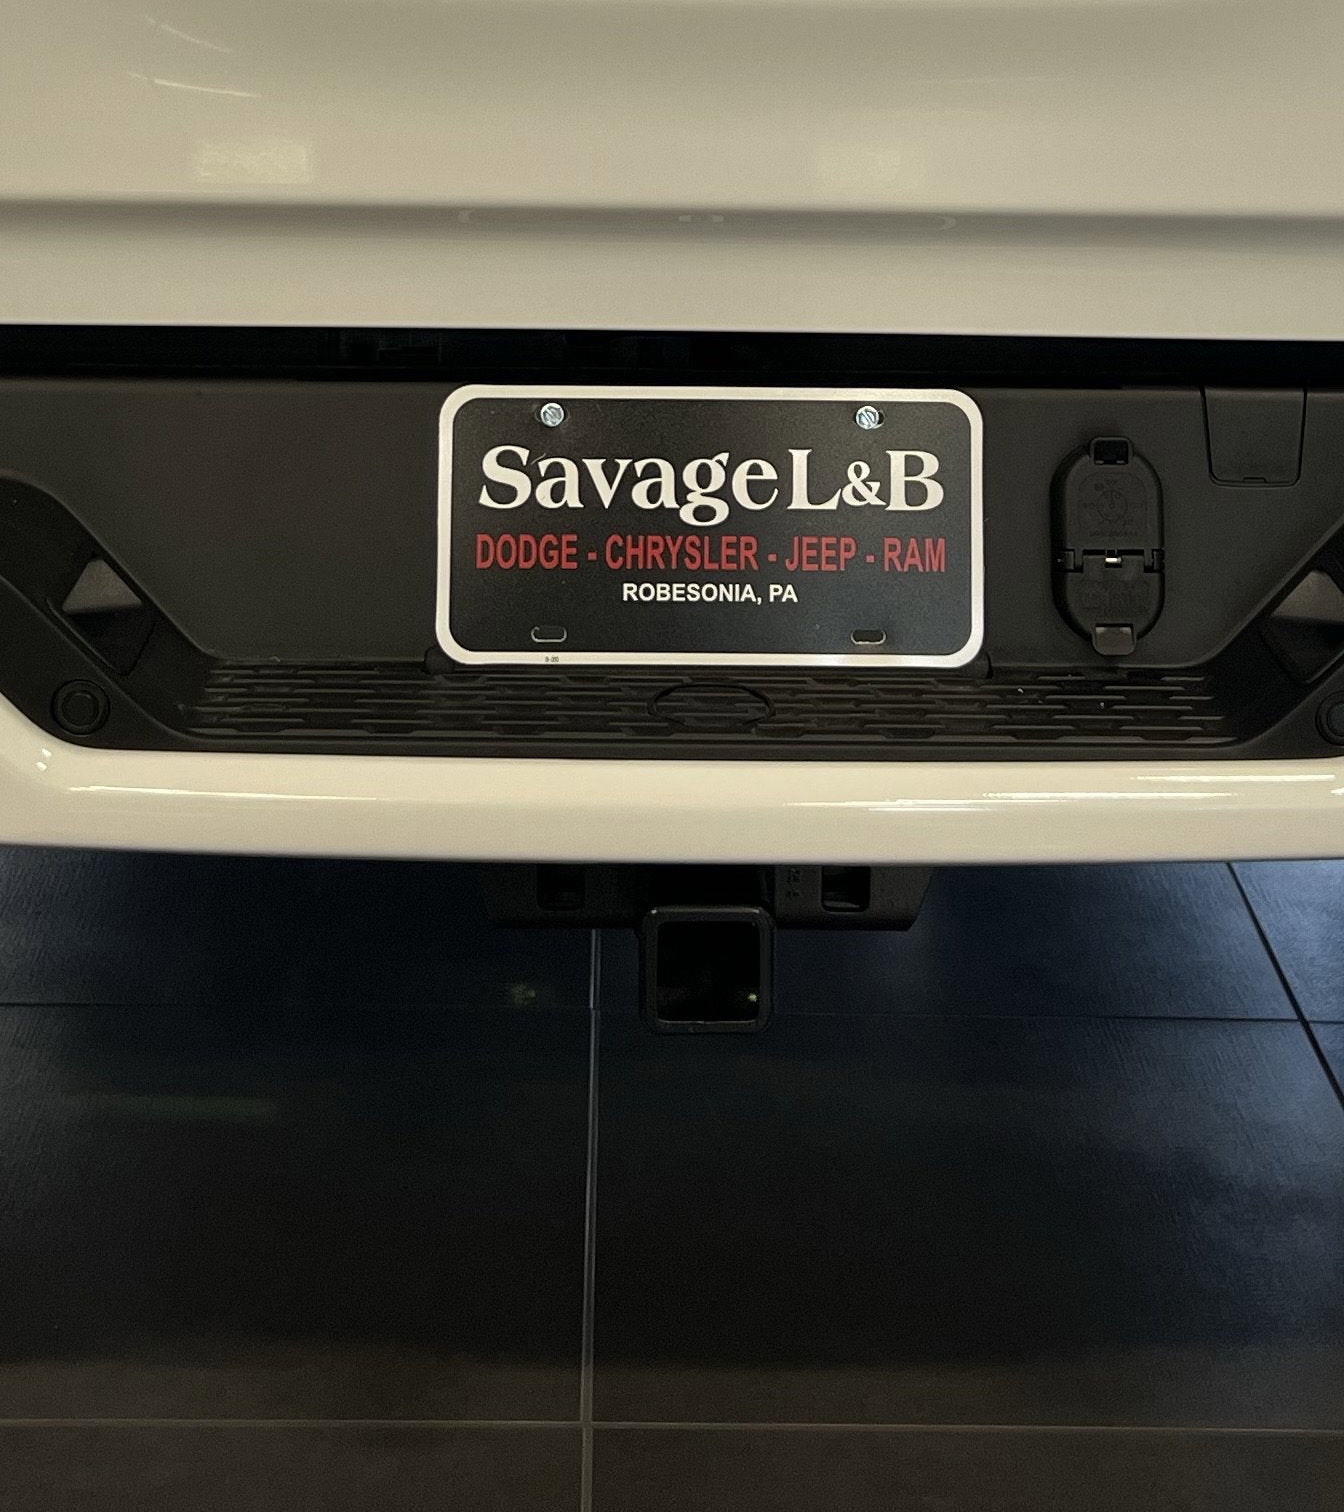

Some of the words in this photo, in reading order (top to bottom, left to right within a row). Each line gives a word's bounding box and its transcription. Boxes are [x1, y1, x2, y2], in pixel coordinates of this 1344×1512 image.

[478, 444, 779, 527] Savage
[787, 448, 945, 511] L&B
[474, 532, 579, 571] DODGE
[604, 534, 759, 572] CHRYSLER
[784, 536, 857, 573] JEEP
[883, 537, 946, 574] RAM
[622, 582, 763, 605] ROBESONIA,
[768, 584, 799, 604] PA
